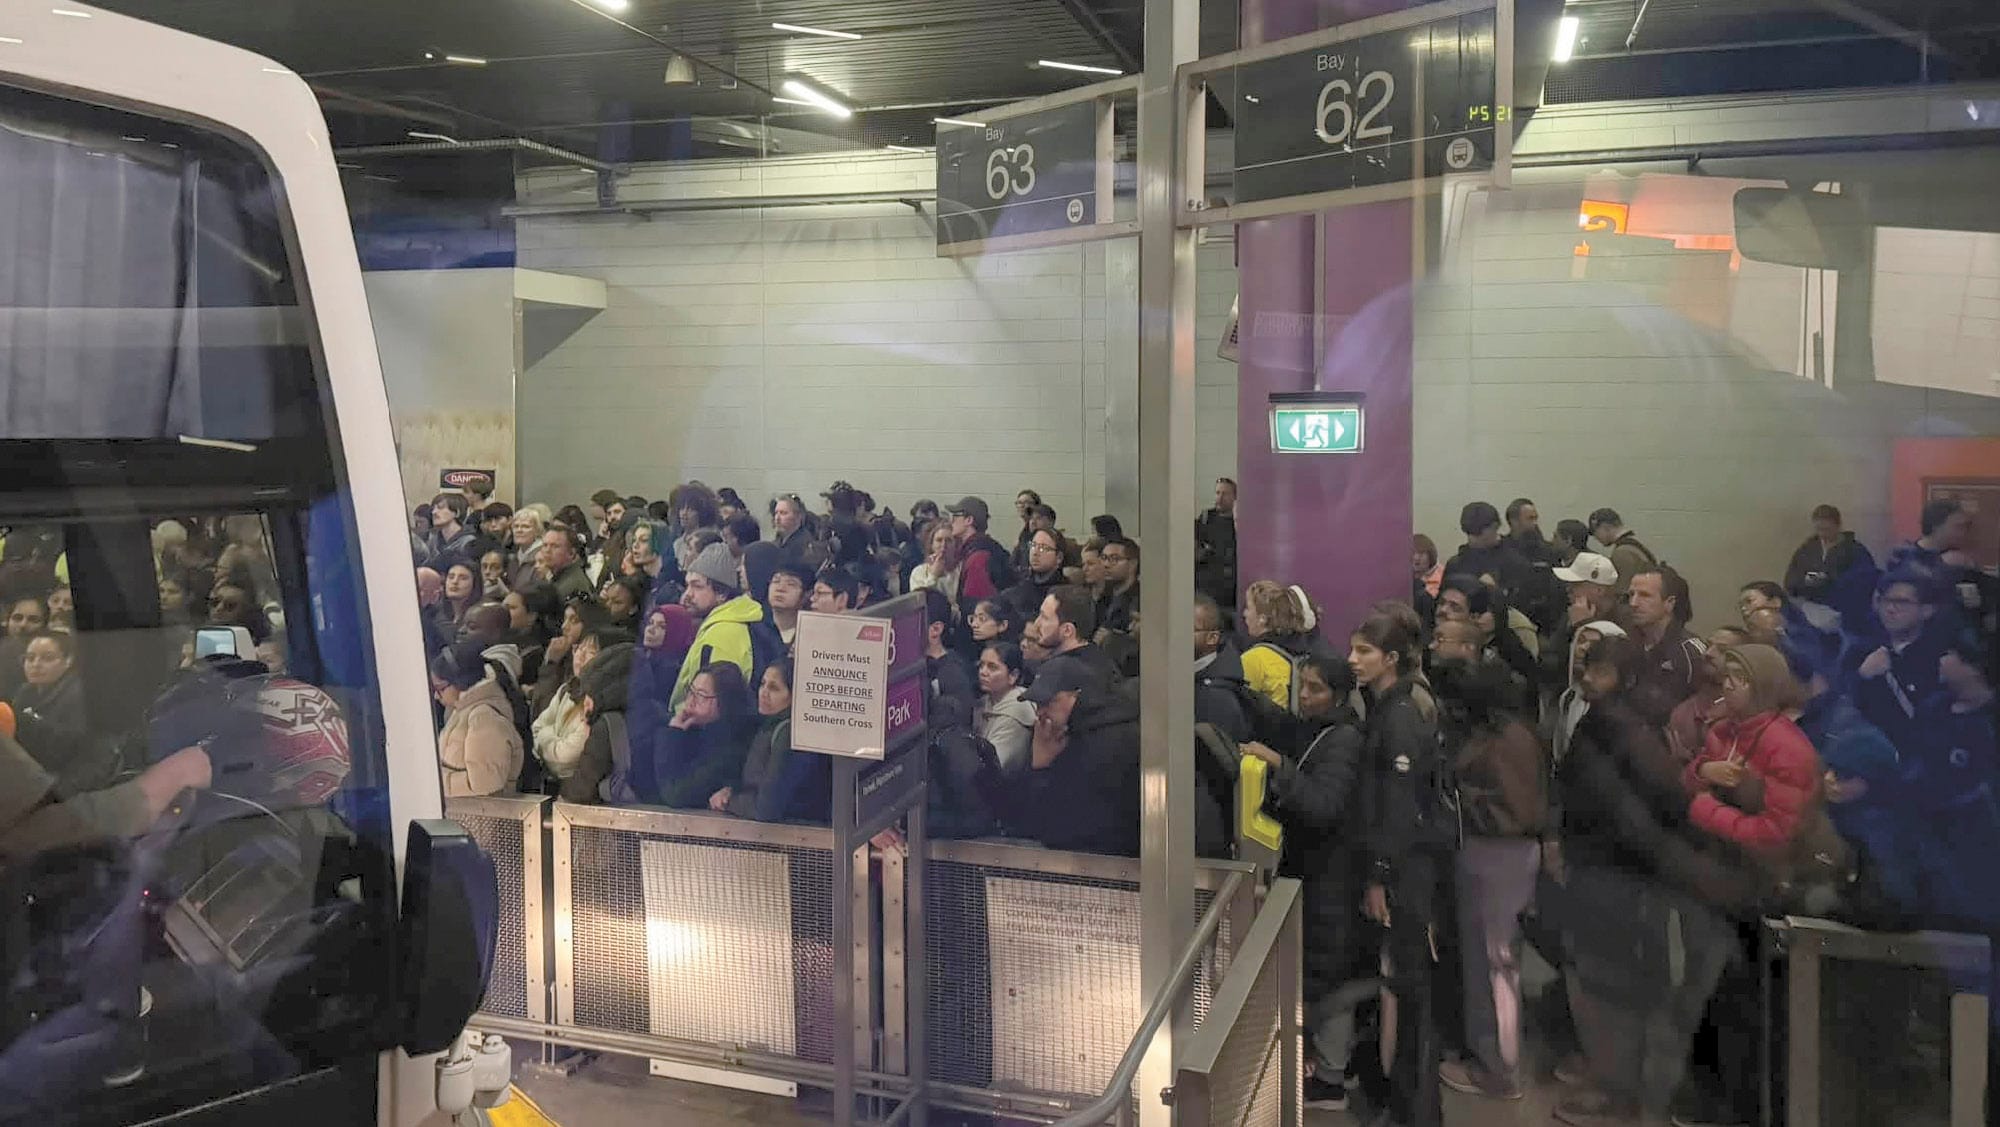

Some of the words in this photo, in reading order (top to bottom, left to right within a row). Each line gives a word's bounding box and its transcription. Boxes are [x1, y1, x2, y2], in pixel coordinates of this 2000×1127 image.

[1317, 53, 1345, 71] Bay
[1316, 71, 1394, 143] 62
[985, 128, 1005, 142] Bay
[986, 143, 1036, 199] 63
[811, 650, 845, 661] Drivers
[846, 653, 871, 664] Must
[813, 666, 868, 681] ANNOUNCE
[805, 682, 835, 695] STOPS
[837, 685, 874, 699] BEFORE
[811, 698, 866, 714] DEPARTING
[888, 698, 911, 730] Park
[803, 712, 846, 726] Southern
[847, 717, 873, 728] Cross
